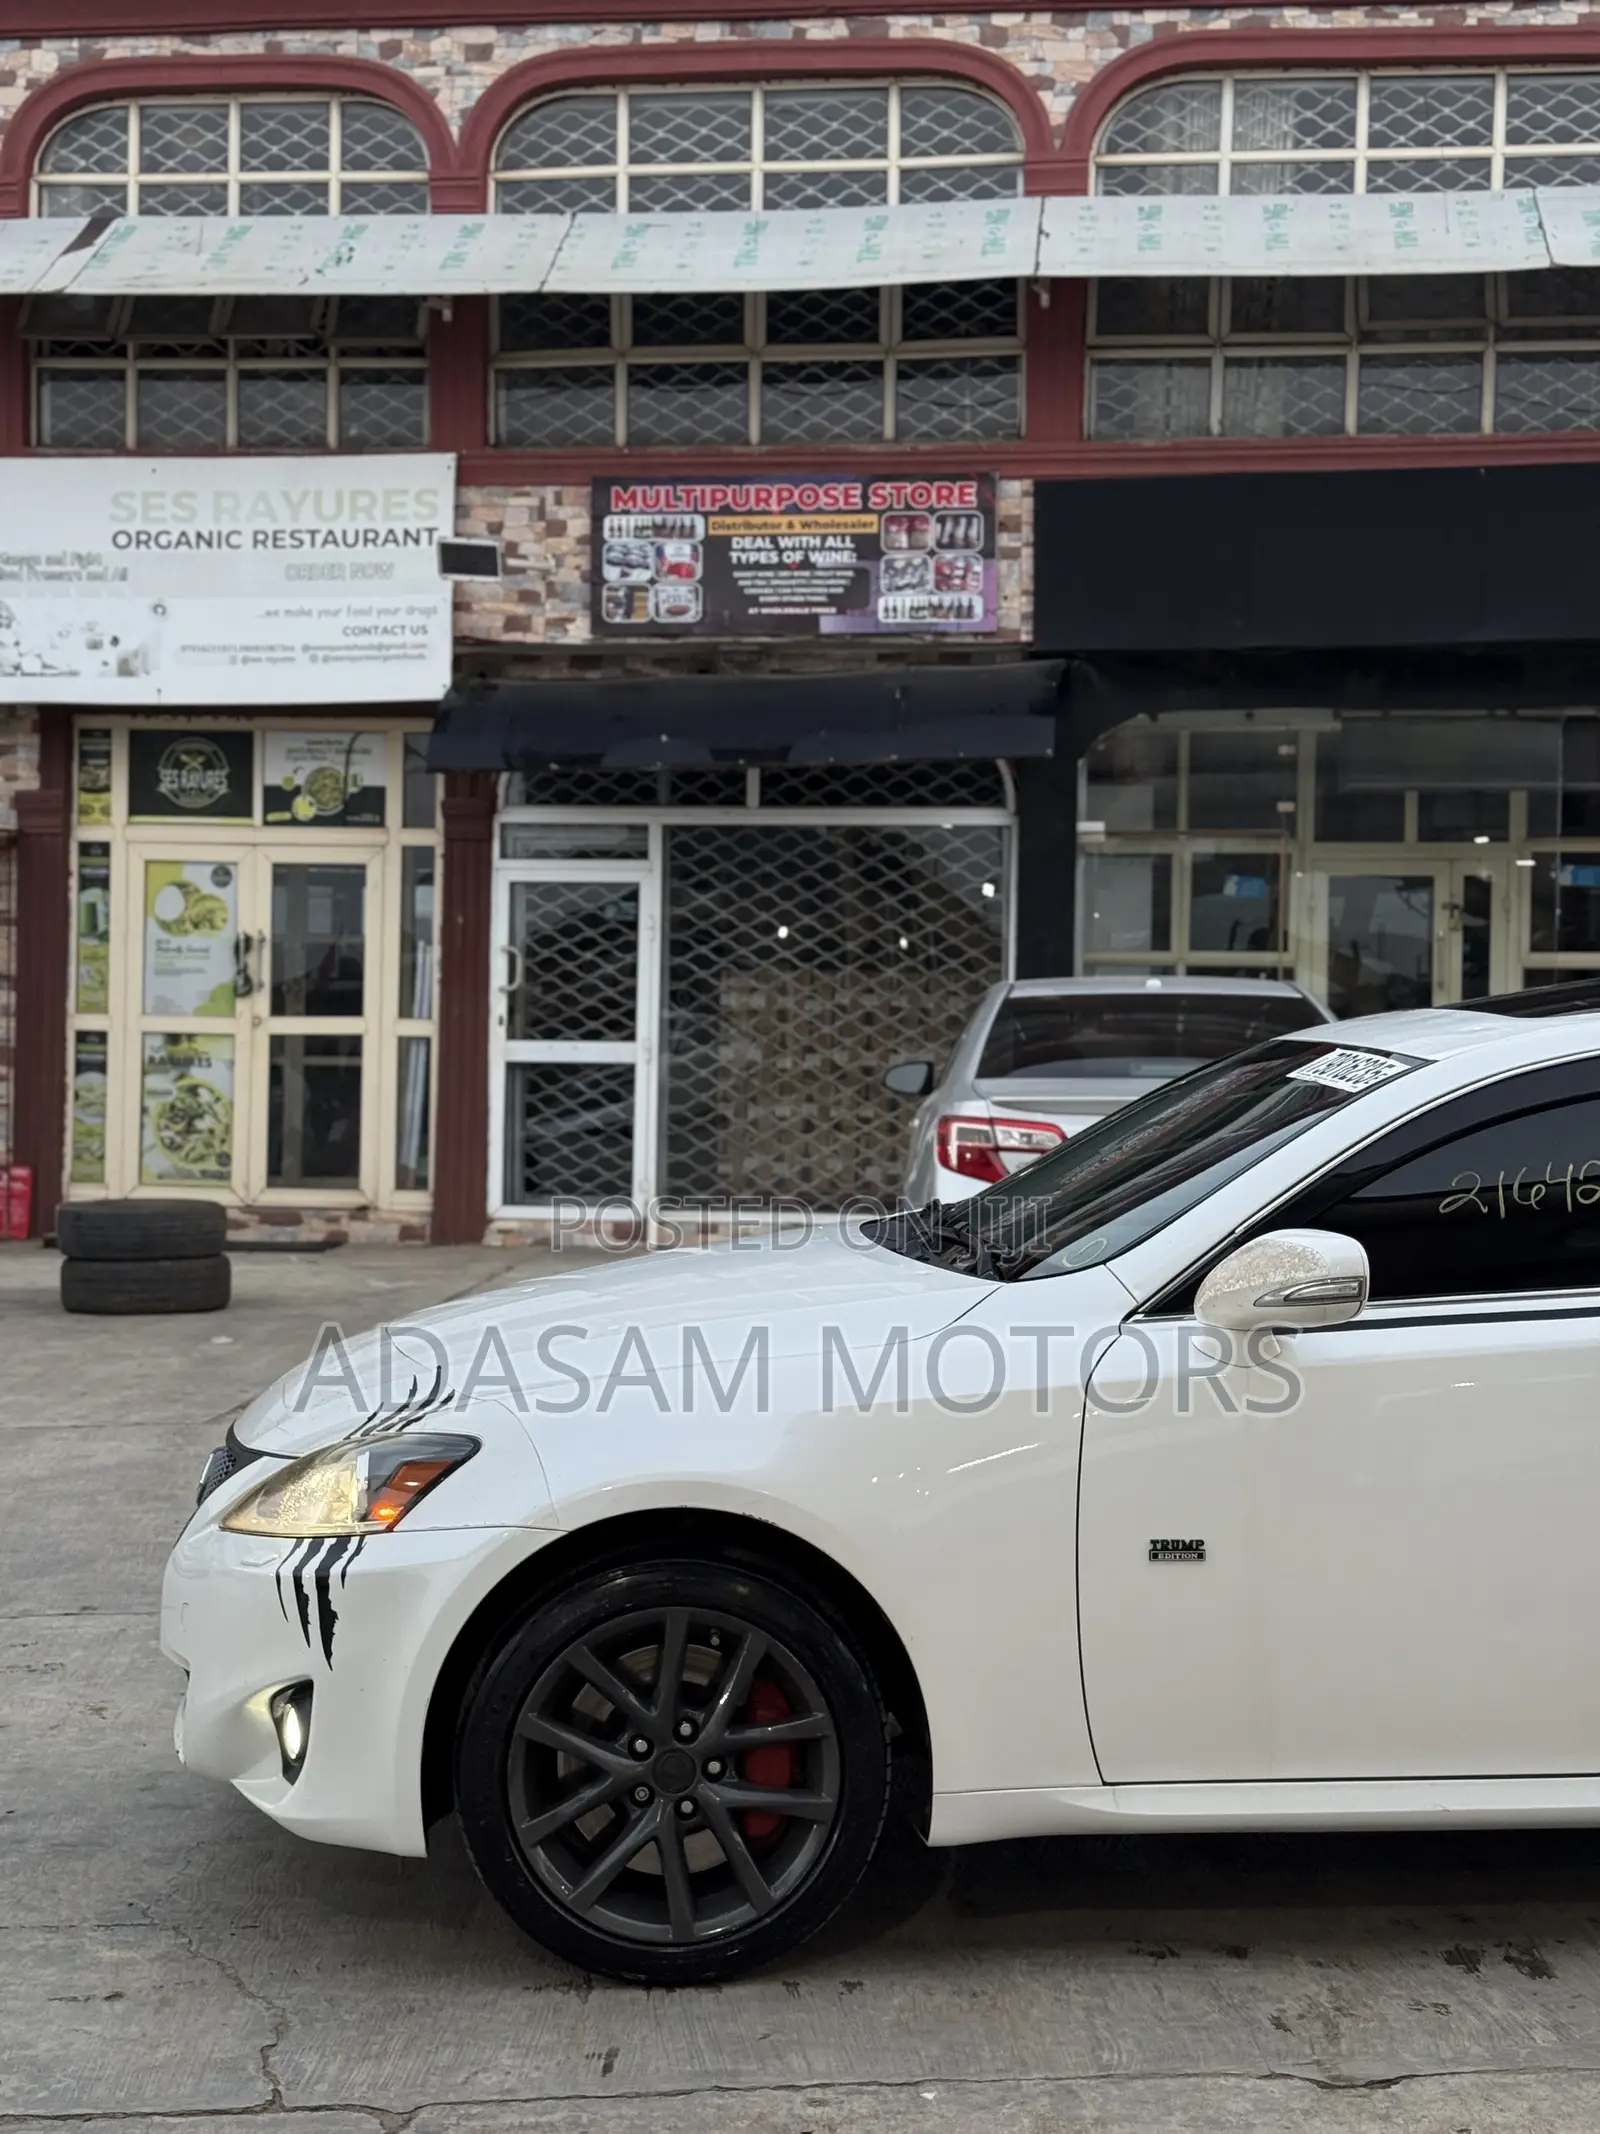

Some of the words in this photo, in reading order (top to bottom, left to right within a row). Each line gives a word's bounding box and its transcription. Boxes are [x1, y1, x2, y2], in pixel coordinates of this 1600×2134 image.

[610, 484, 862, 512] MULTIPURPOSE
[868, 481, 977, 511] STORE
[109, 489, 198, 524] SES
[212, 487, 440, 524] RAYURES
[711, 519, 782, 530] Distributor
[786, 519, 795, 530] &
[800, 518, 875, 530] Wholesaler
[112, 529, 244, 550] ORGANIC
[252, 527, 440, 549] RESTAURANT
[731, 535, 775, 549] DEAL
[777, 535, 822, 549] WITH
[824, 534, 856, 549] ALL
[729, 550, 779, 564] TYPES
[782, 550, 804, 564] OF
[809, 549, 857, 564] WINE:
[342, 625, 406, 637] CONTACT
[410, 624, 429, 636] US
[1149, 1539, 1205, 1550] TRUMP
